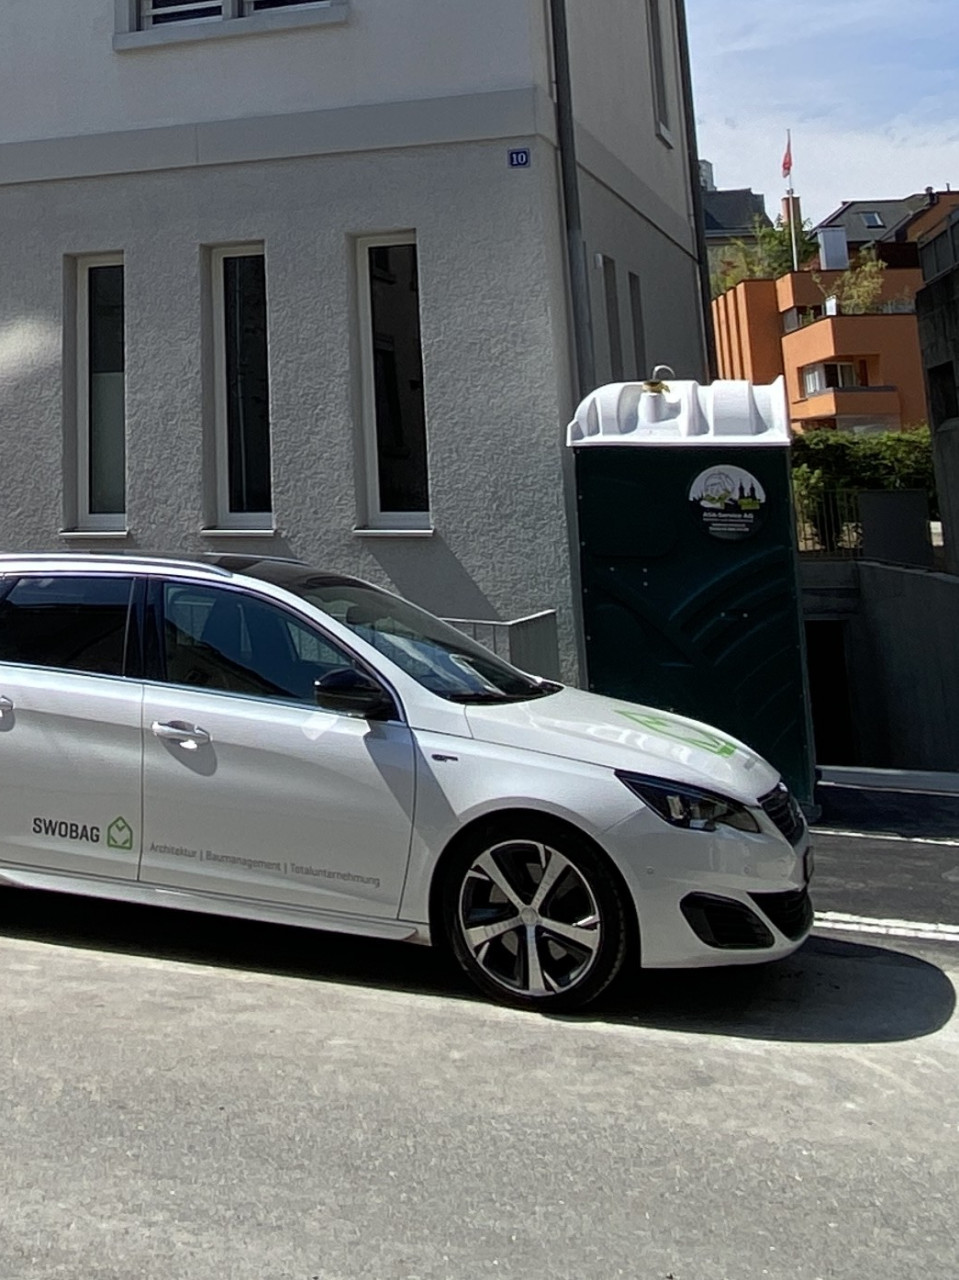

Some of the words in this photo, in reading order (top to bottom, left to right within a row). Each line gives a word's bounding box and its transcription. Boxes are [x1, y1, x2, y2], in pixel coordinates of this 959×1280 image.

[512, 152, 526, 165] 10
[32, 817, 100, 843] SWOBAG
[150, 843, 198, 858] Architektur
[205, 850, 281, 872] Baumanagement
[290, 863, 380, 888] Totalunternehmung
